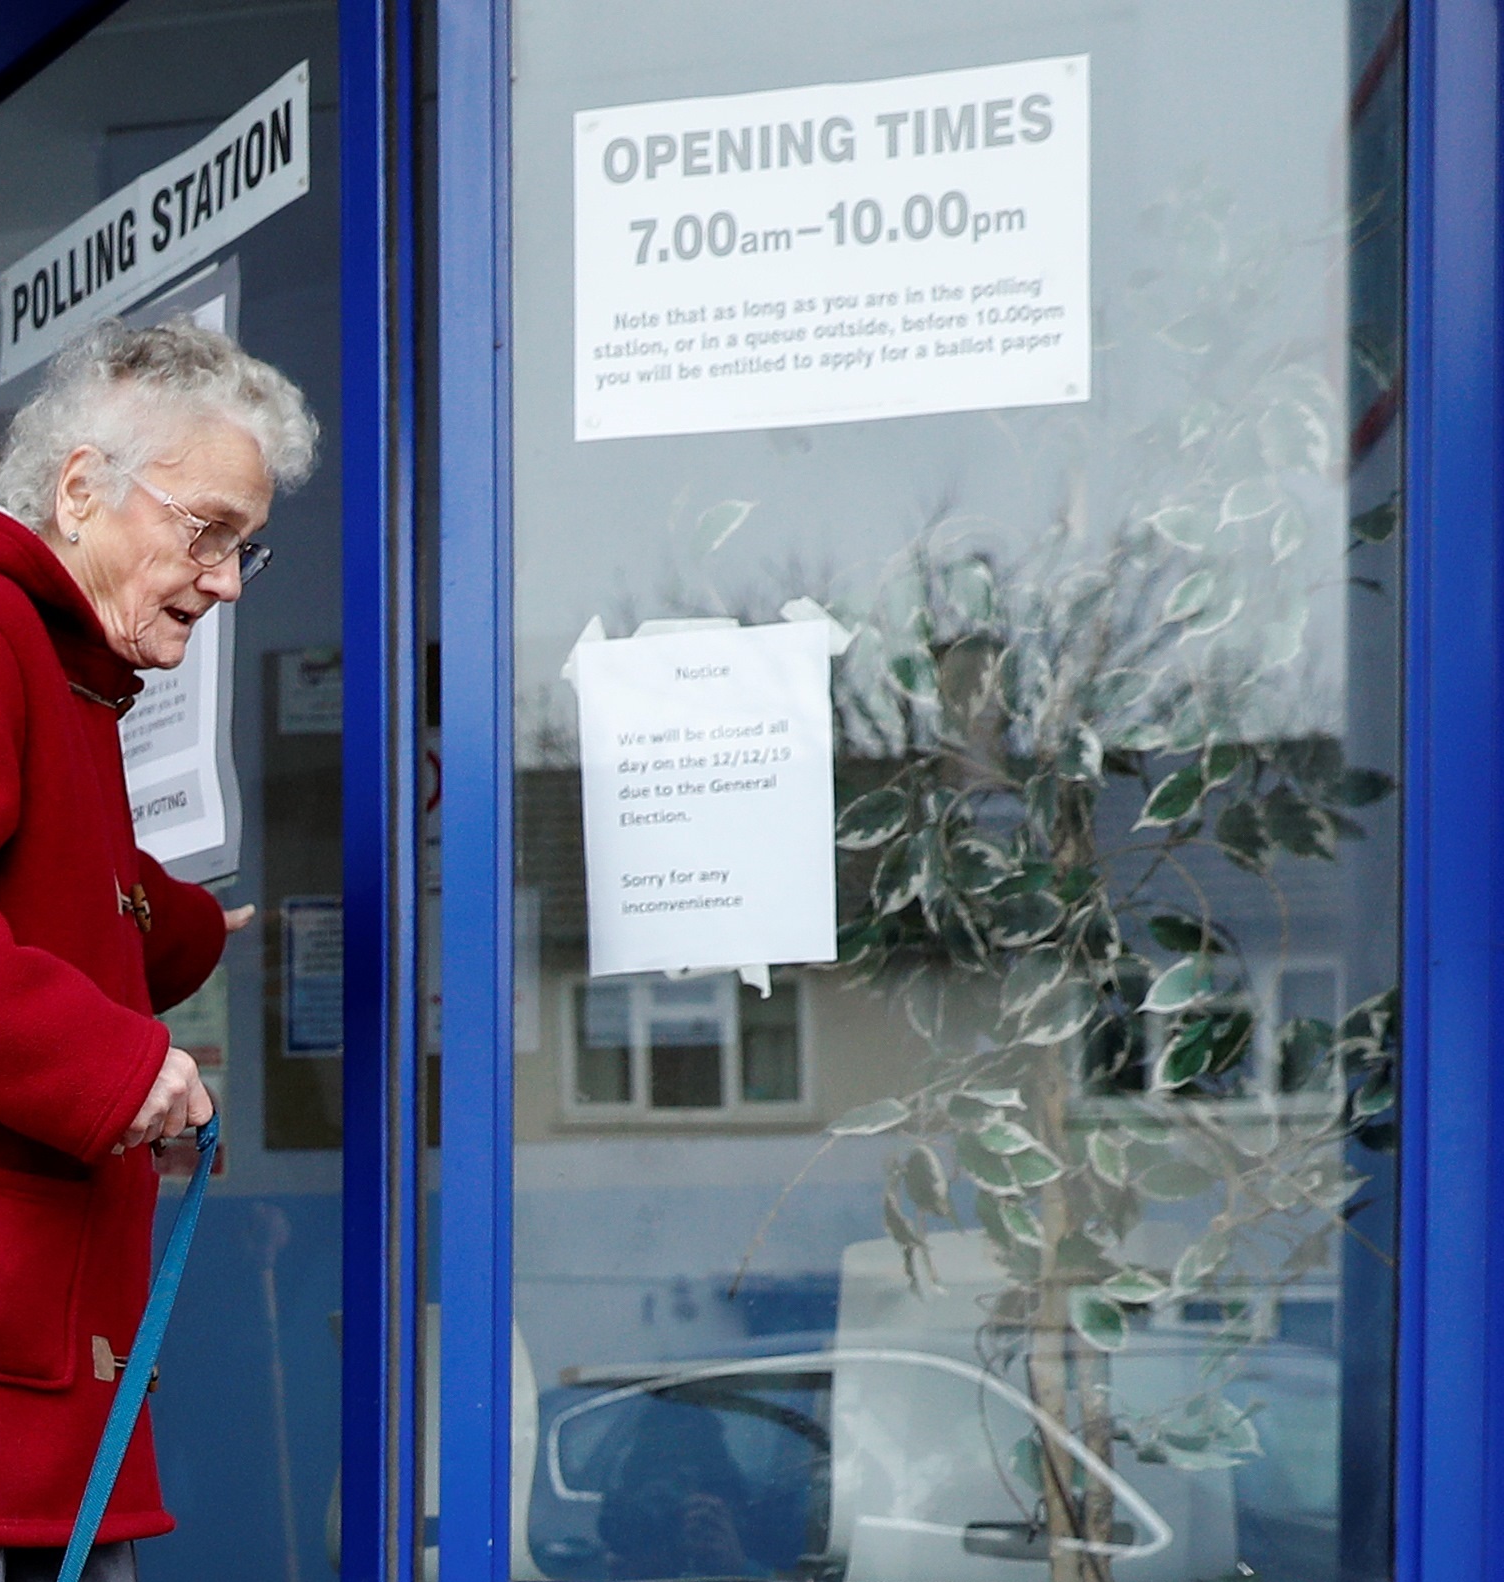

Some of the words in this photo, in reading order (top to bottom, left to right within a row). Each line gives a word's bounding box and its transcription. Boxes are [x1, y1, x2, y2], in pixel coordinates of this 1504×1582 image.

[602, 116, 856, 184] OPENING
[875, 93, 1054, 160] TIMES
[12, 207, 138, 346] POLLING
[151, 99, 293, 253] STATION
[613, 312, 660, 331] Note
[666, 305, 707, 325] that
[713, 304, 736, 322] as
[743, 299, 787, 320] long
[793, 297, 816, 314] as
[824, 294, 858, 315] you
[864, 290, 898, 307] are
[905, 286, 924, 304] in
[932, 283, 964, 301] the
[970, 276, 1043, 303] polling
[593, 338, 669, 361] station,
[674, 336, 694, 353] or
[701, 332, 721, 350] in
[726, 332, 739, 348] a
[744, 325, 807, 350] queue
[813, 317, 895, 339] outside,
[901, 310, 969, 334] before
[977, 303, 1066, 328] 10.00pm
[595, 369, 631, 391] you
[637, 363, 672, 383] will
[678, 361, 702, 380] be
[709, 353, 787, 377] entitled
[793, 351, 814, 369] to
[819, 347, 875, 370] apply
[880, 343, 909, 362] for
[914, 342, 928, 359] a
[934, 335, 994, 358] ballot
[1001, 330, 1063, 355] paper
[674, 662, 731, 682] Notice
[617, 731, 647, 747] We
[651, 727, 681, 744] will
[685, 725, 705, 741] be
[709, 721, 764, 740] closed
[768, 718, 789, 735] all
[618, 757, 649, 777] day
[652, 756, 675, 772] on
[680, 752, 707, 769] the
[711, 745, 792, 769] 12/12/19
[619, 782, 651, 801] due
[654, 781, 673, 799] to
[677, 778, 706, 796] the
[708, 774, 778, 795] General
[146, 790, 189, 818] VOTING
[618, 808, 692, 828] Election.
[621, 871, 665, 889] Sorry
[669, 869, 695, 886] for
[698, 867, 731, 886] any
[621, 893, 744, 916] inconvenience
